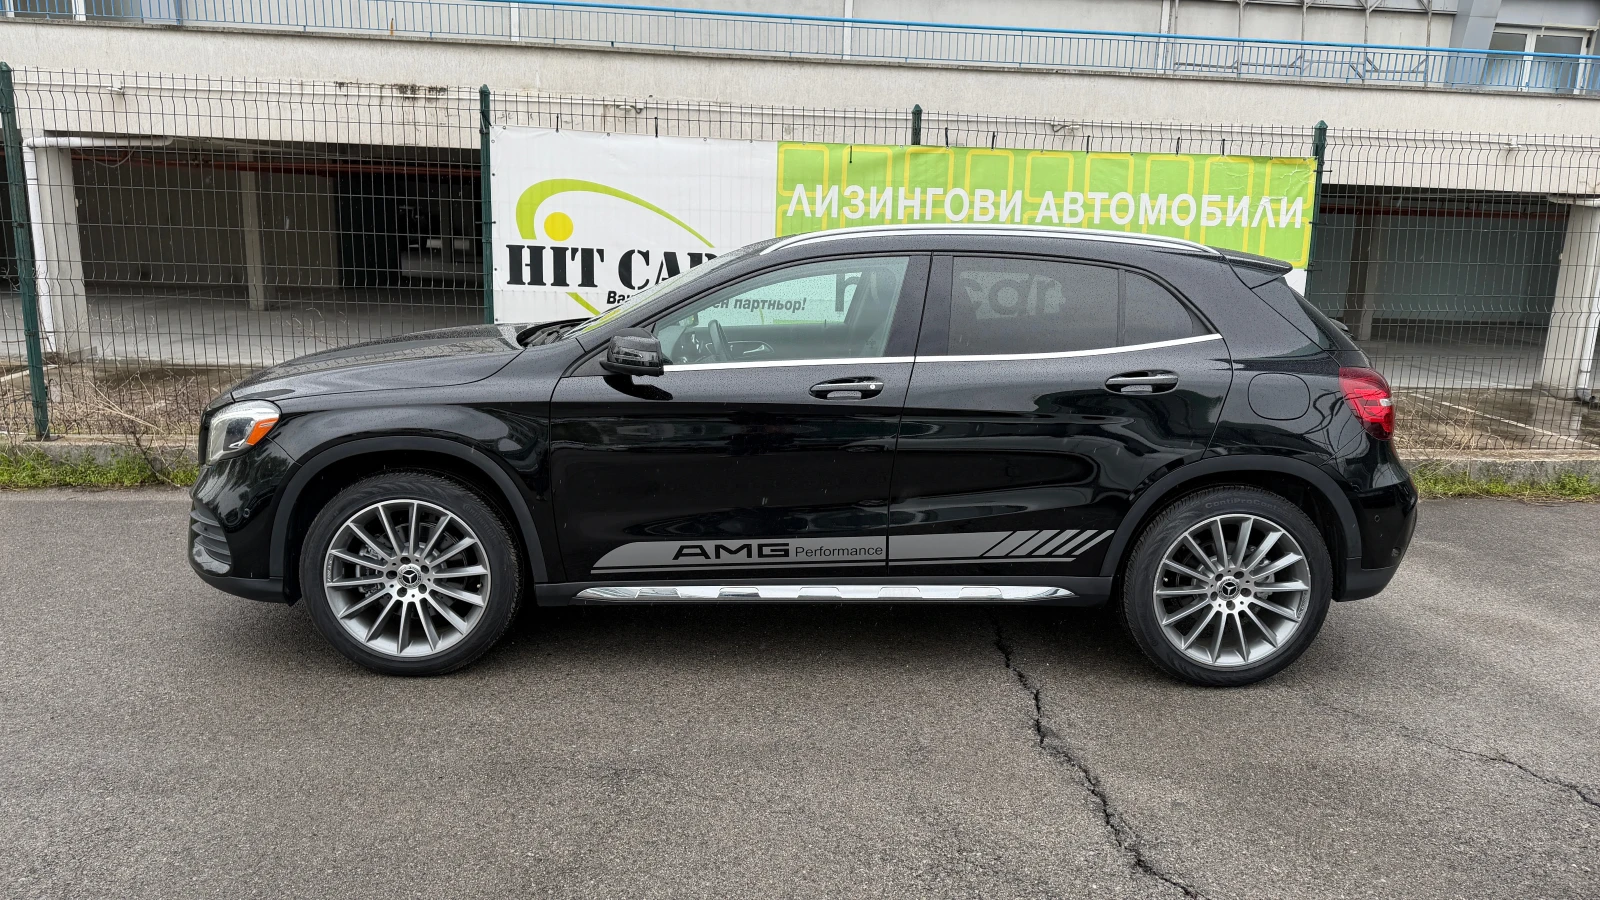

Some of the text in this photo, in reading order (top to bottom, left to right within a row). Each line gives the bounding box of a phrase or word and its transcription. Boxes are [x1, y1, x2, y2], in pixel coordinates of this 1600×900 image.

[786, 183, 1304, 229] ЛИЗИНГОВИ АВТОМОБИЛИ
[505, 244, 605, 288] HIT
[733, 297, 807, 314] партньор!
[672, 542, 884, 561] AMG Performance
